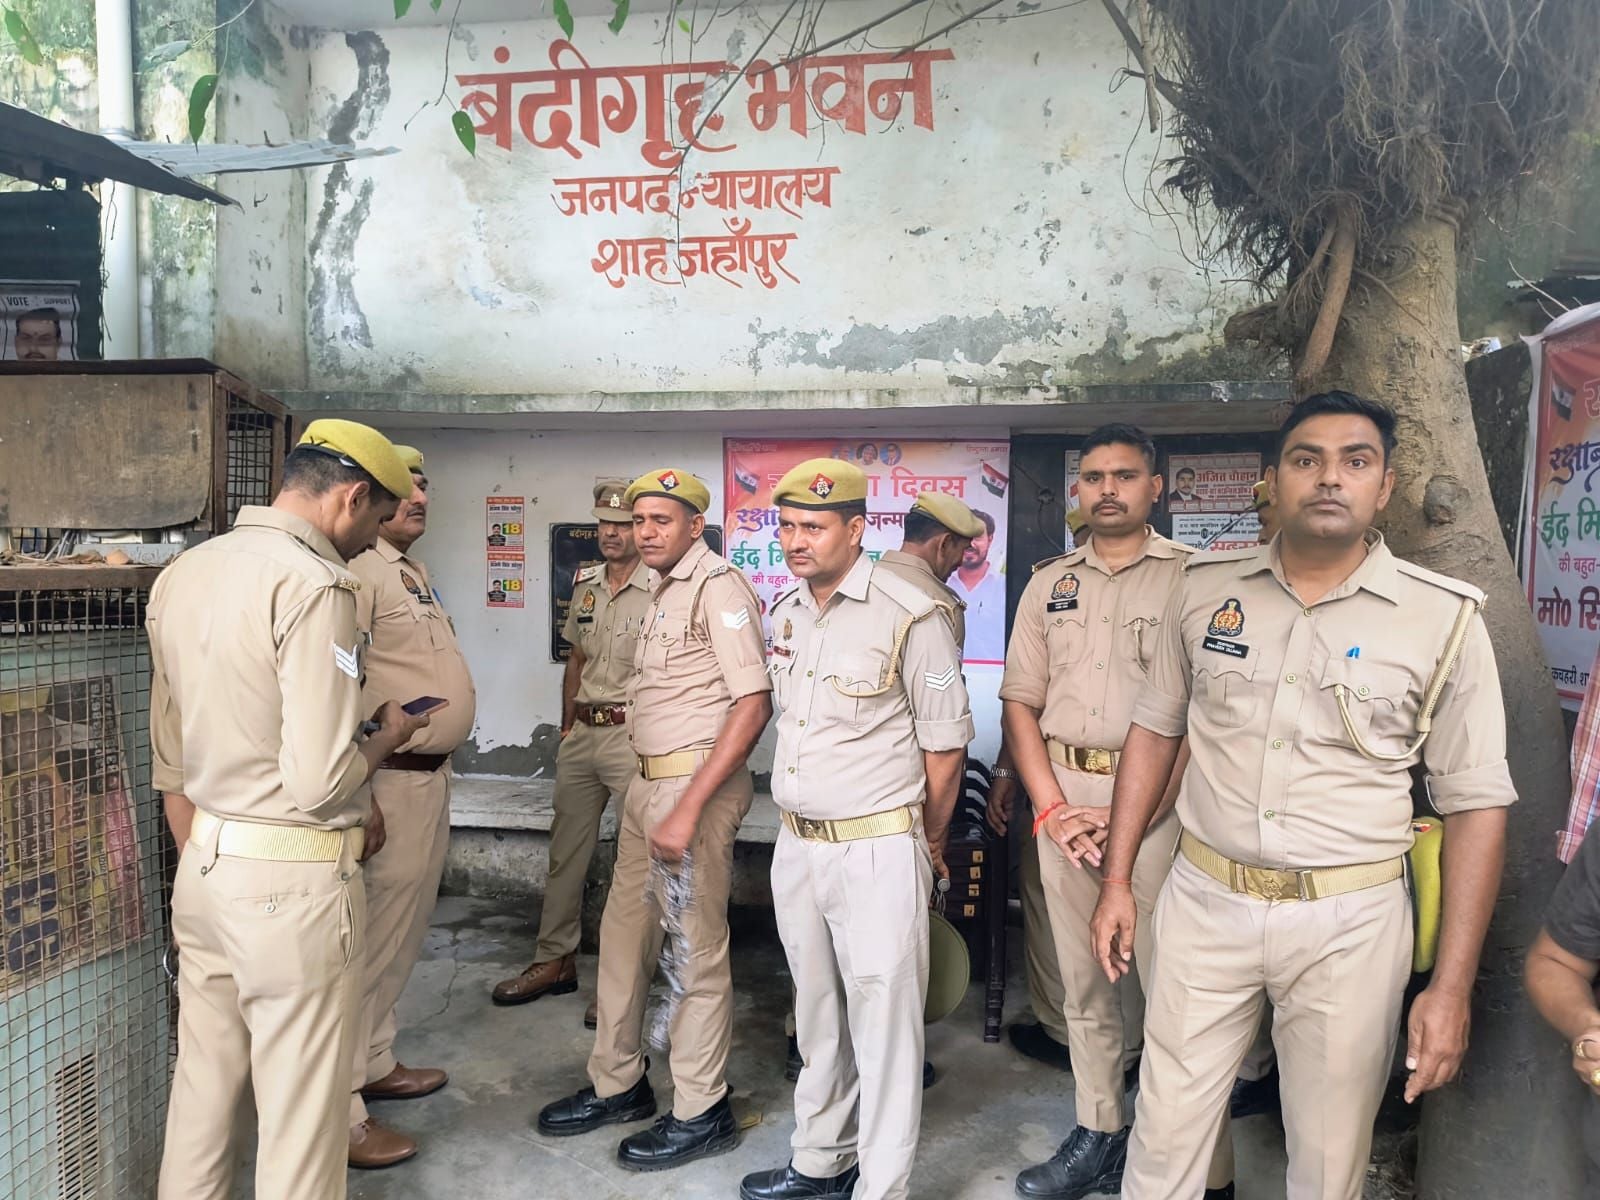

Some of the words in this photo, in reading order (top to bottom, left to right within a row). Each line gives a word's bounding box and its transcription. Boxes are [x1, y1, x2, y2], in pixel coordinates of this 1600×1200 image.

[455, 38, 740, 168] बंदीगृह
[745, 48, 955, 138] भवन
[550, 174, 681, 221] जनपद
[680, 166, 841, 219] न्यायालय
[6, 296, 30, 306] VOTE
[891, 466, 967, 497] दिवस
[503, 523, 521, 534] 18
[1541, 500, 1571, 550] ईद
[730, 540, 761, 570] ईद
[1559, 551, 1571, 573] की
[503, 579, 521, 591] 18
[752, 571, 764, 585] की
